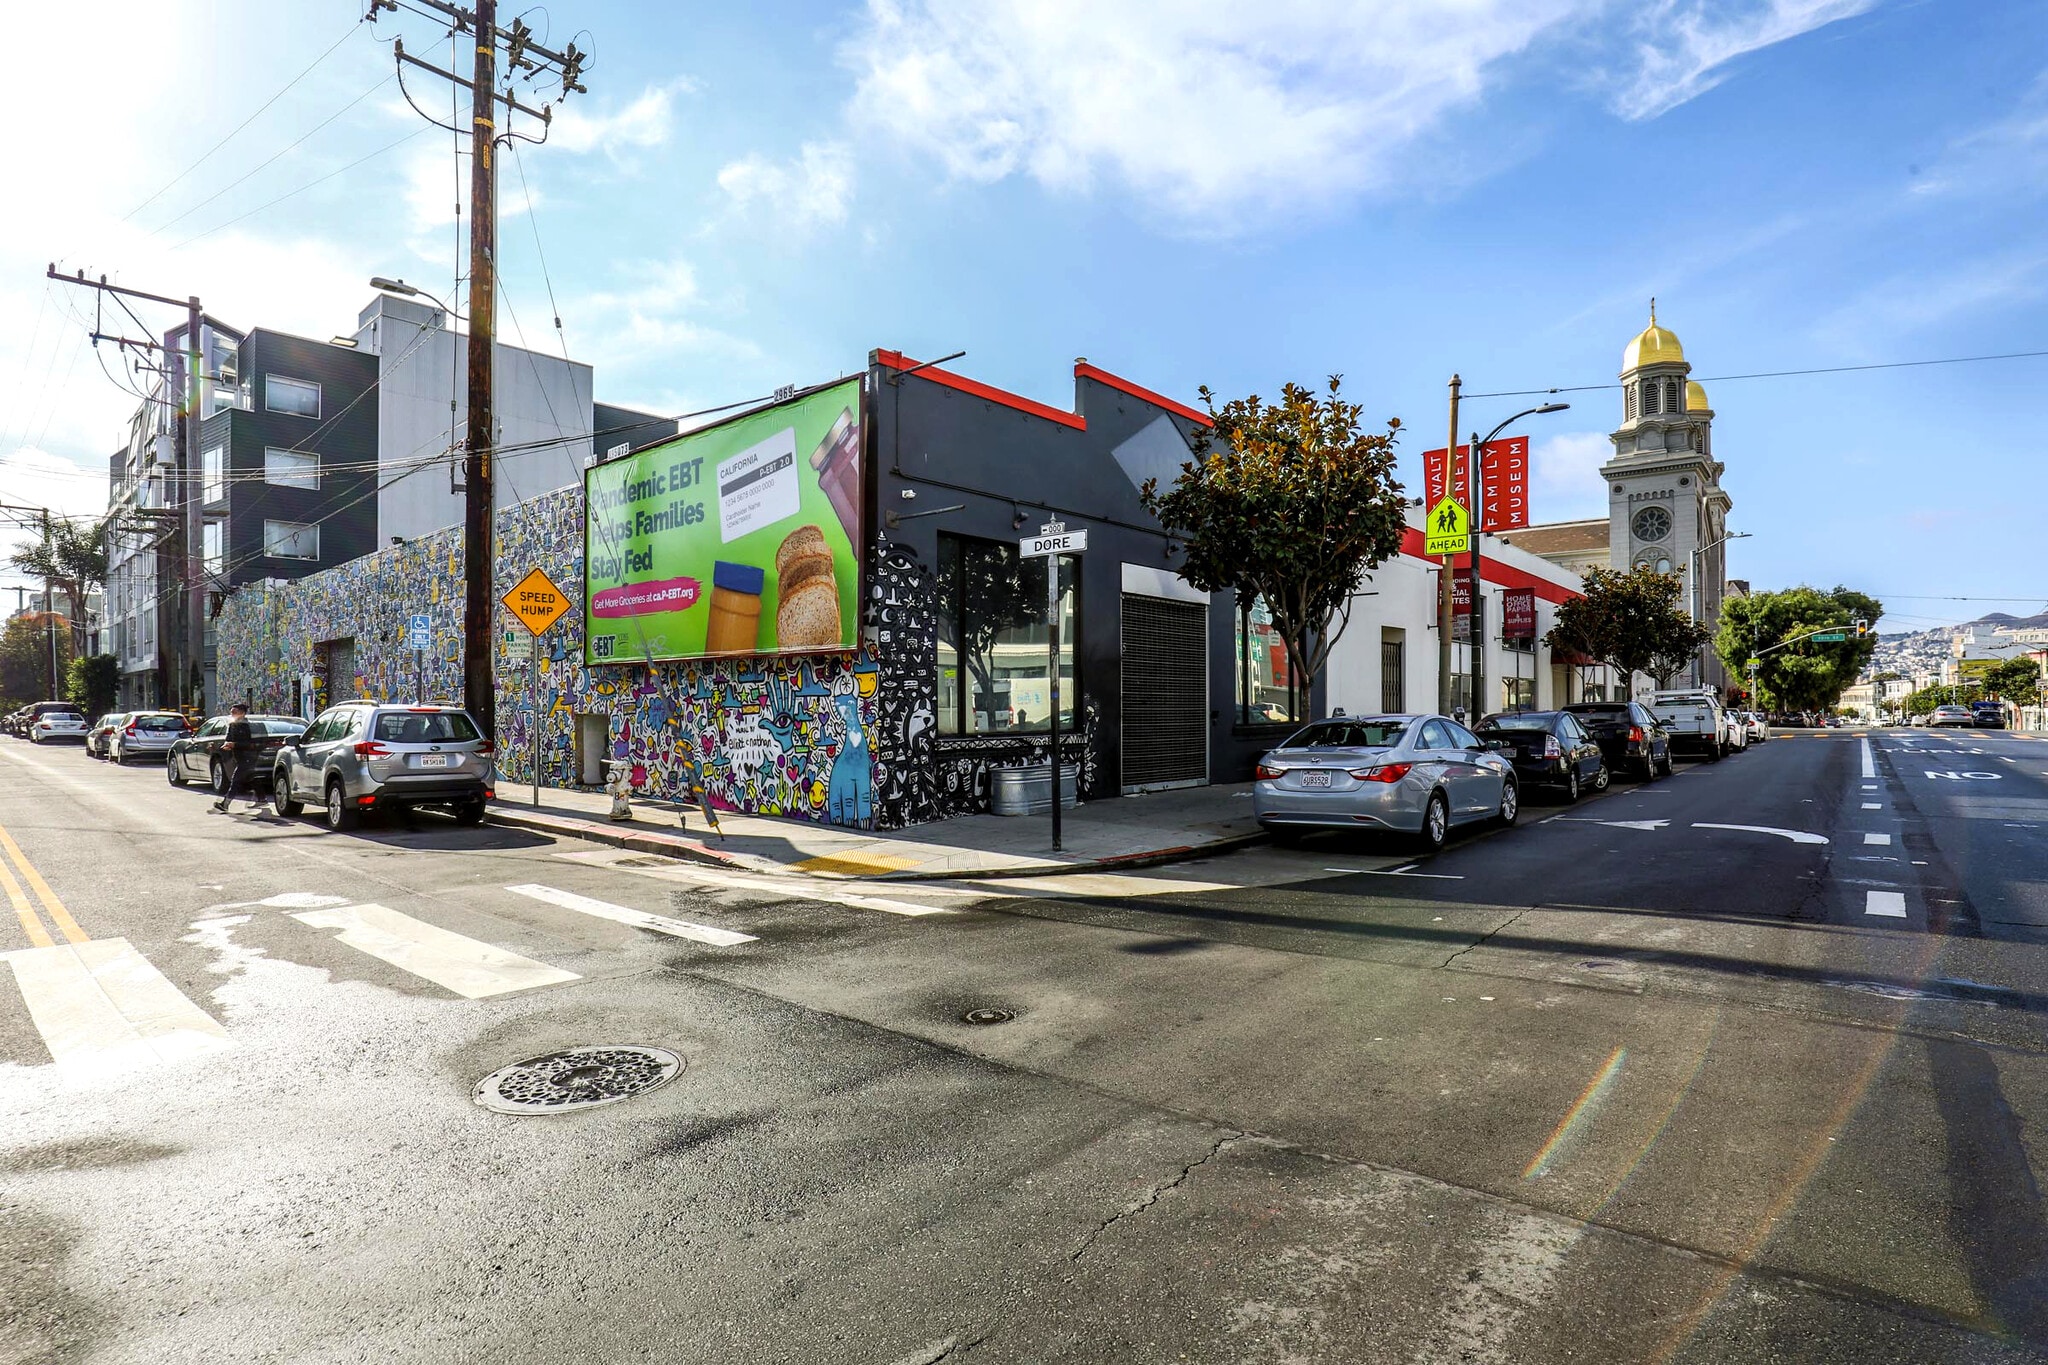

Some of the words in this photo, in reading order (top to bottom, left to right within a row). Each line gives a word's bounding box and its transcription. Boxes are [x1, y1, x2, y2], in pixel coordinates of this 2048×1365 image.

[720, 453, 758, 479] CALIFORNIA
[760, 462, 777, 477] P-EBT
[780, 456, 790, 468] 2.0
[1431, 456, 1442, 498] WALT
[591, 471, 666, 510] Pandemic
[669, 457, 704, 492] EBT
[1455, 454, 1465, 505] SNEY
[1486, 449, 1498, 526] FAMILY
[1510, 443, 1522, 523] MUSEUM
[592, 518, 633, 548] Helps
[635, 500, 704, 537] Families
[1035, 537, 1070, 551] DORE
[1429, 539, 1464, 550] AHEAD
[591, 556, 622, 583] Stay
[624, 545, 653, 574] Fed
[520, 592, 555, 604] SPEED
[594, 600, 605, 609] Get
[605, 598, 618, 608] More
[619, 594, 645, 606] Groceries
[646, 593, 653, 602] at
[653, 588, 694, 602] ca.P-EBT.org
[521, 606, 554, 617] HUMP
[598, 635, 616, 657] EBT
[1924, 770, 2002, 780] NO
